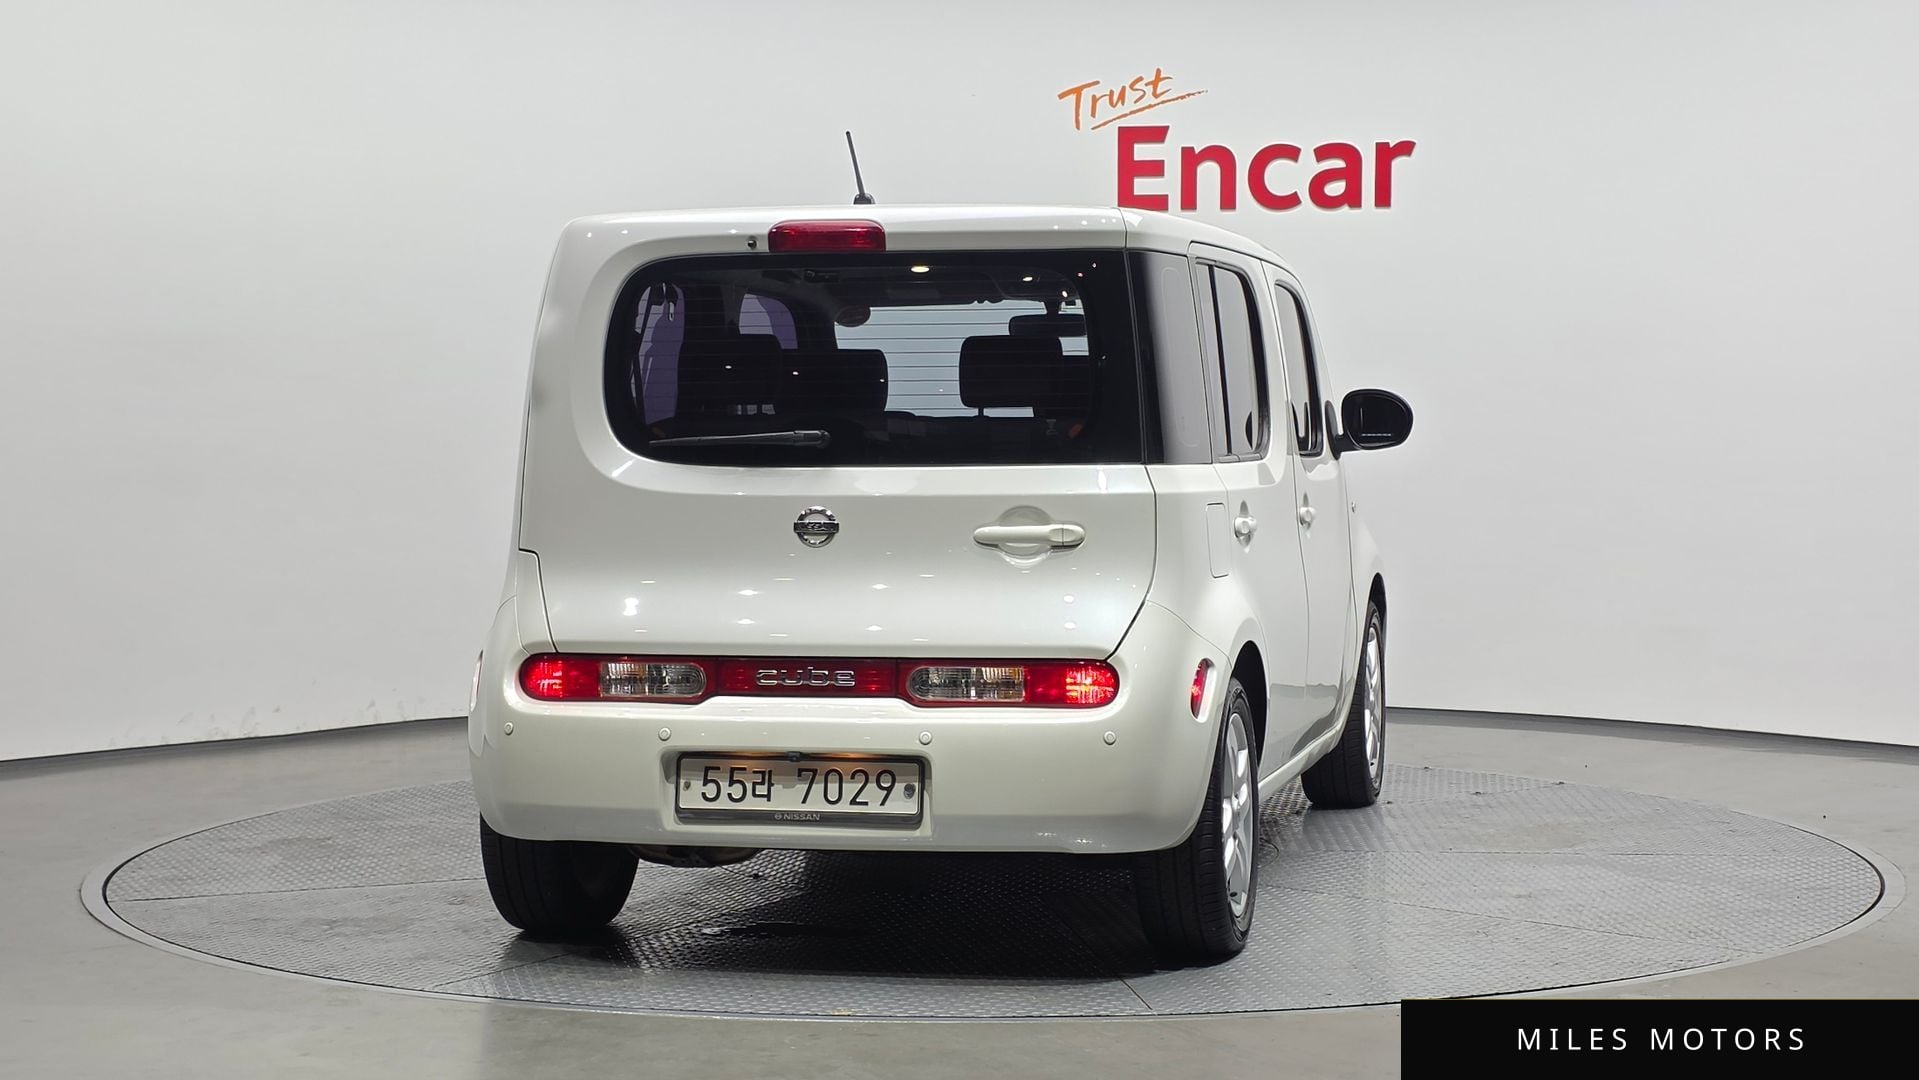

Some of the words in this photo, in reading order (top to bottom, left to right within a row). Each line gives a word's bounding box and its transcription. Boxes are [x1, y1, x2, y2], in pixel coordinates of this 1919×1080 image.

[1057, 67, 1174, 131] Trust
[1116, 125, 1417, 211] Encar
[756, 666, 856, 687] cube
[701, 765, 775, 803] 55라
[797, 767, 897, 807] 7029
[783, 812, 821, 822] NISSAN
